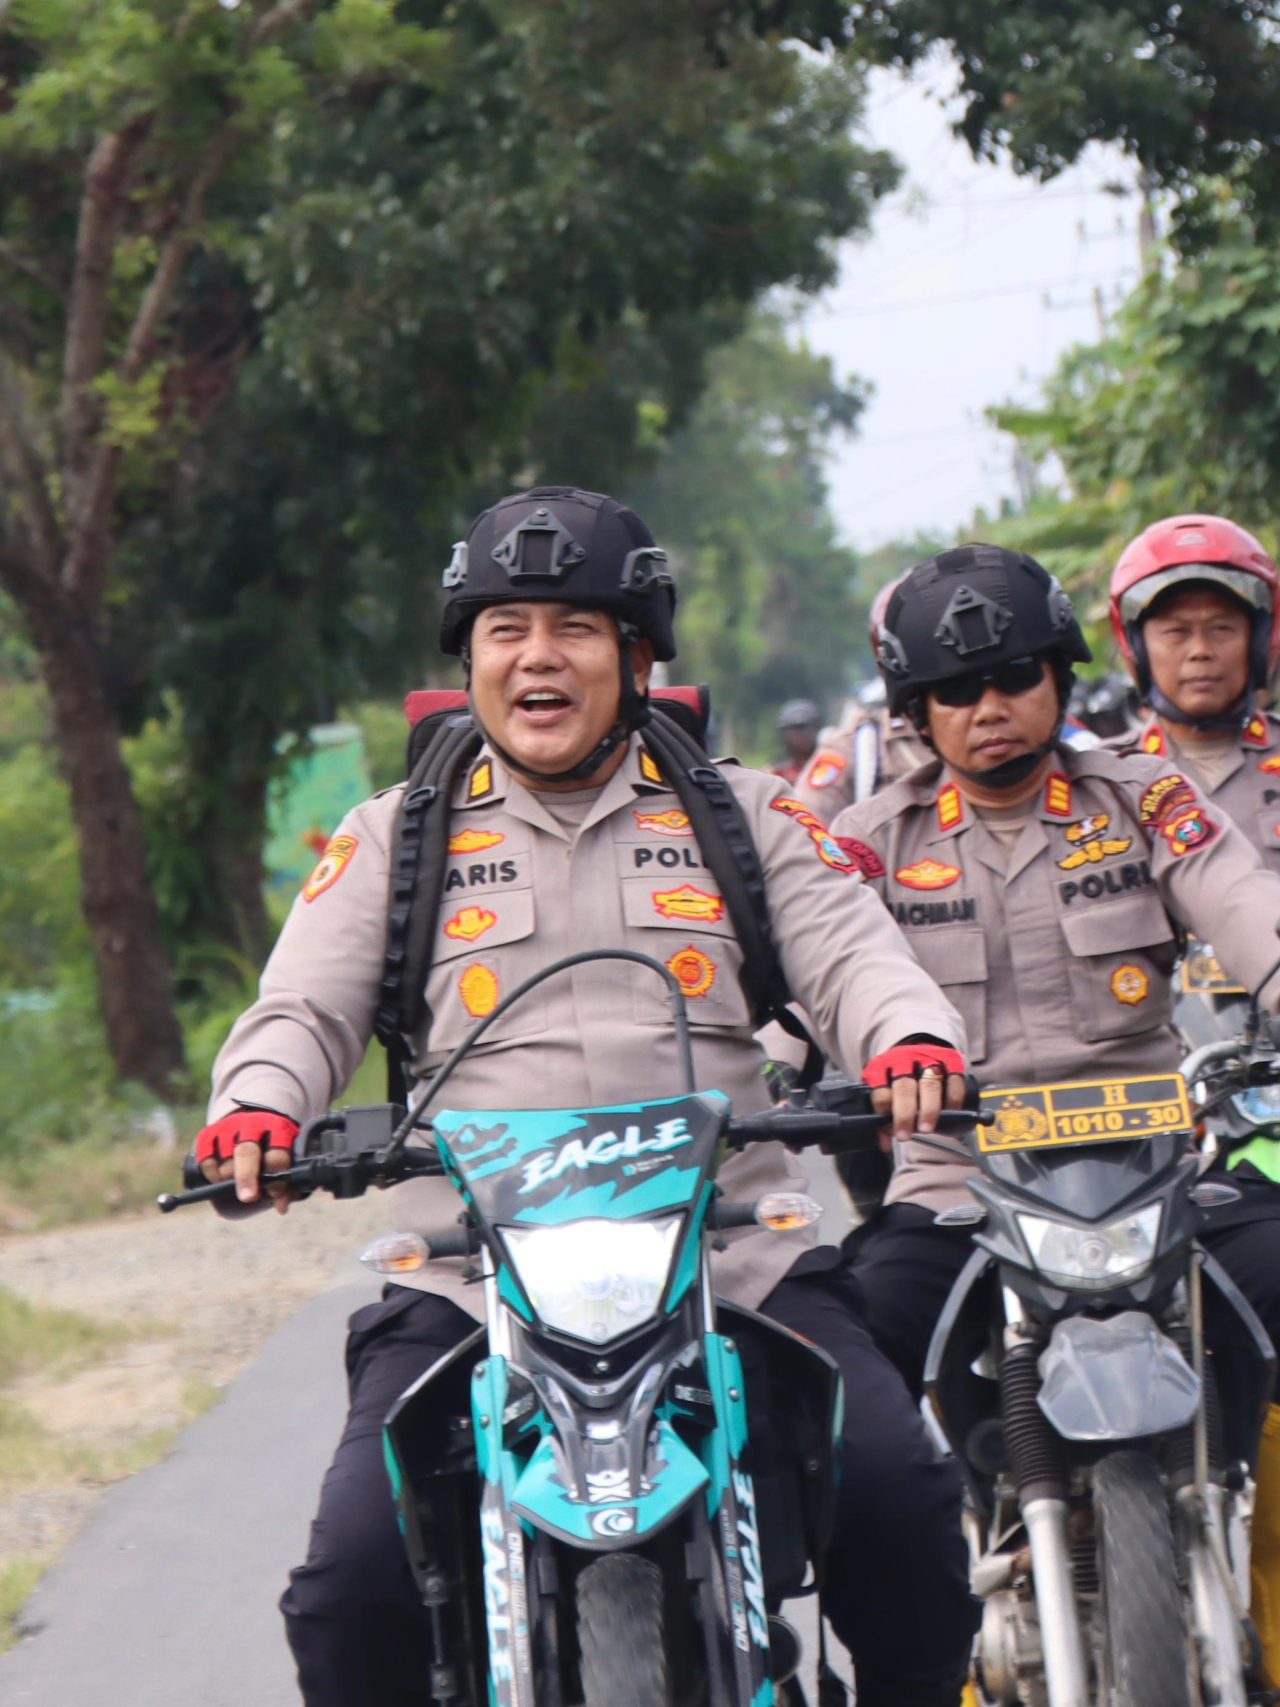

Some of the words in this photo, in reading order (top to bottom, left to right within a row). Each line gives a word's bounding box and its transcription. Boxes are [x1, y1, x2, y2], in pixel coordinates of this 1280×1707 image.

[1063, 861, 1150, 904] POLRI
[1058, 1112, 1123, 1135] 1010
[1147, 1106, 1181, 1125] 30
[518, 1117, 694, 1194] EAGLE
